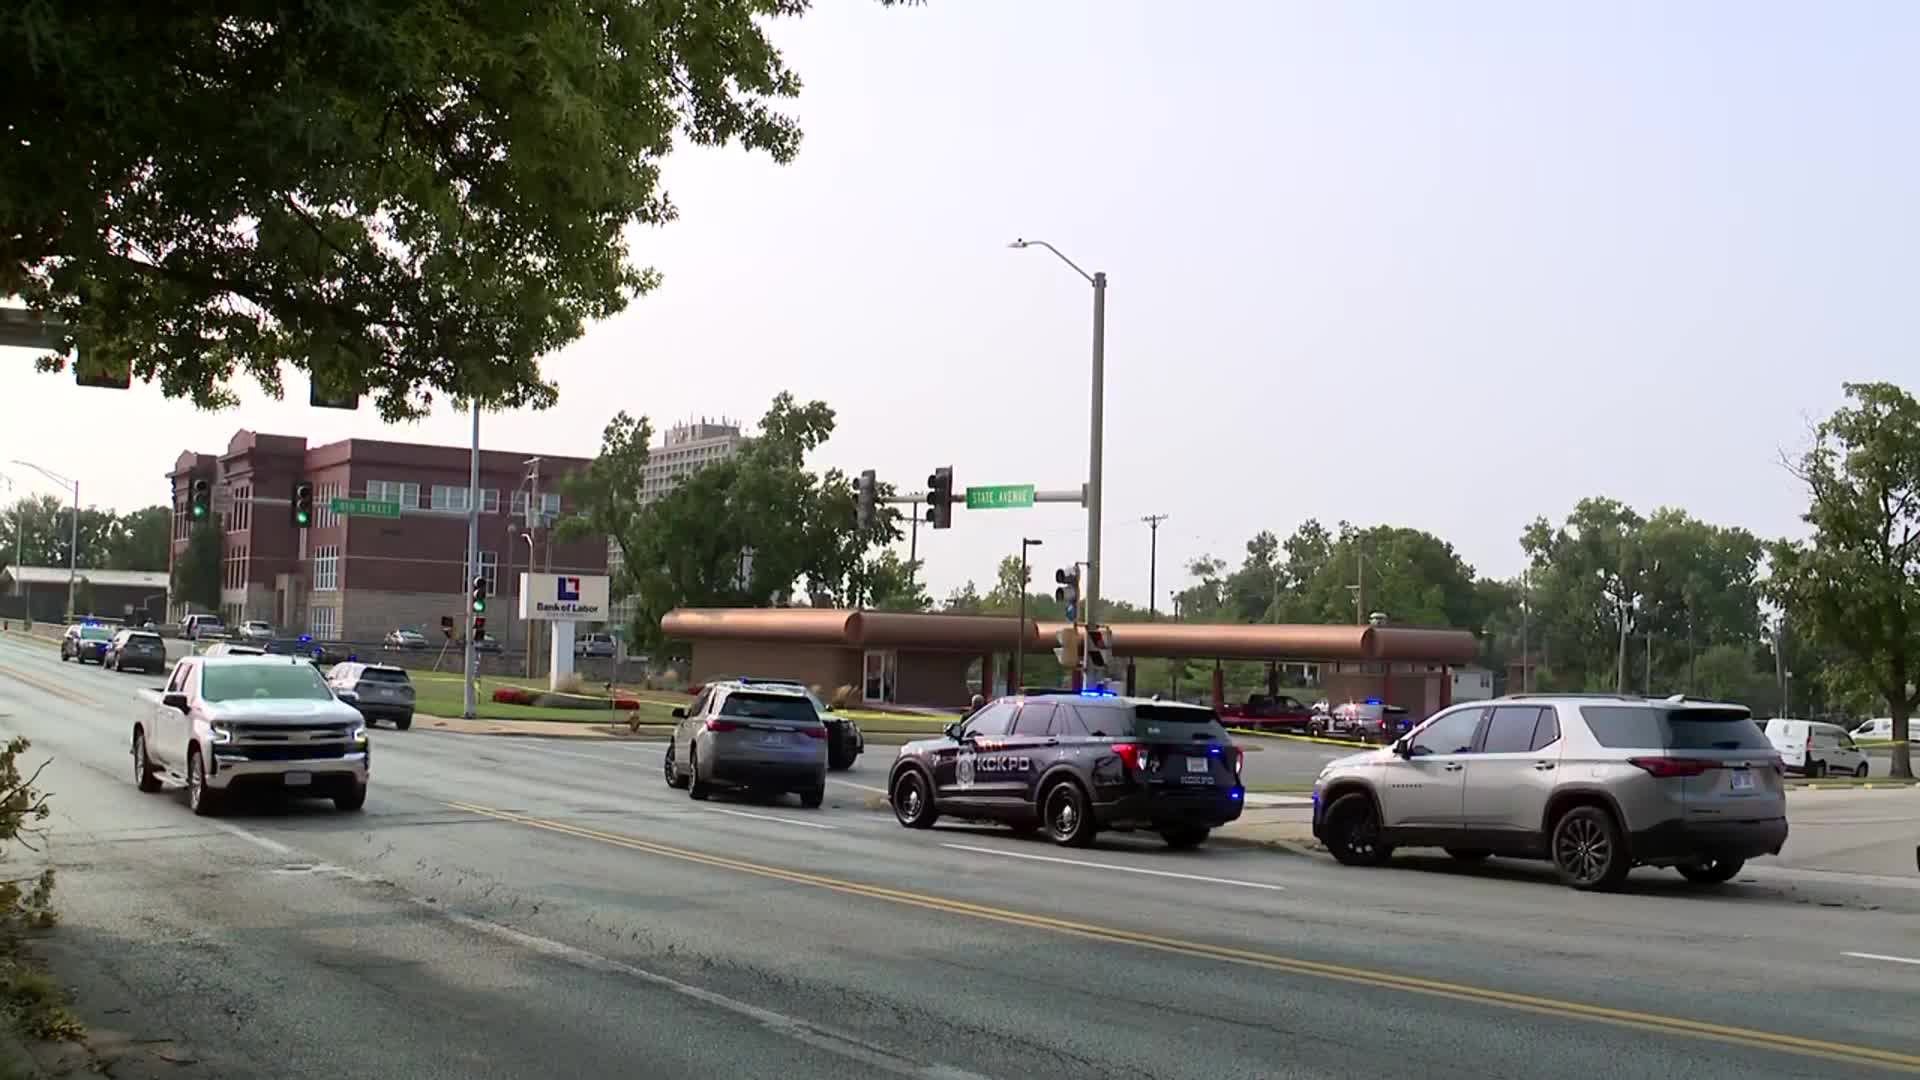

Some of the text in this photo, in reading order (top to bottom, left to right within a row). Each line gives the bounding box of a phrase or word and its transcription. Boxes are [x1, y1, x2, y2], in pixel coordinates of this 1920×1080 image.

[972, 489, 1028, 504] STATE AVENUE
[360, 503, 392, 515] STREET
[537, 602, 599, 613] Bank of Labor
[977, 756, 1030, 771] KCKPD
